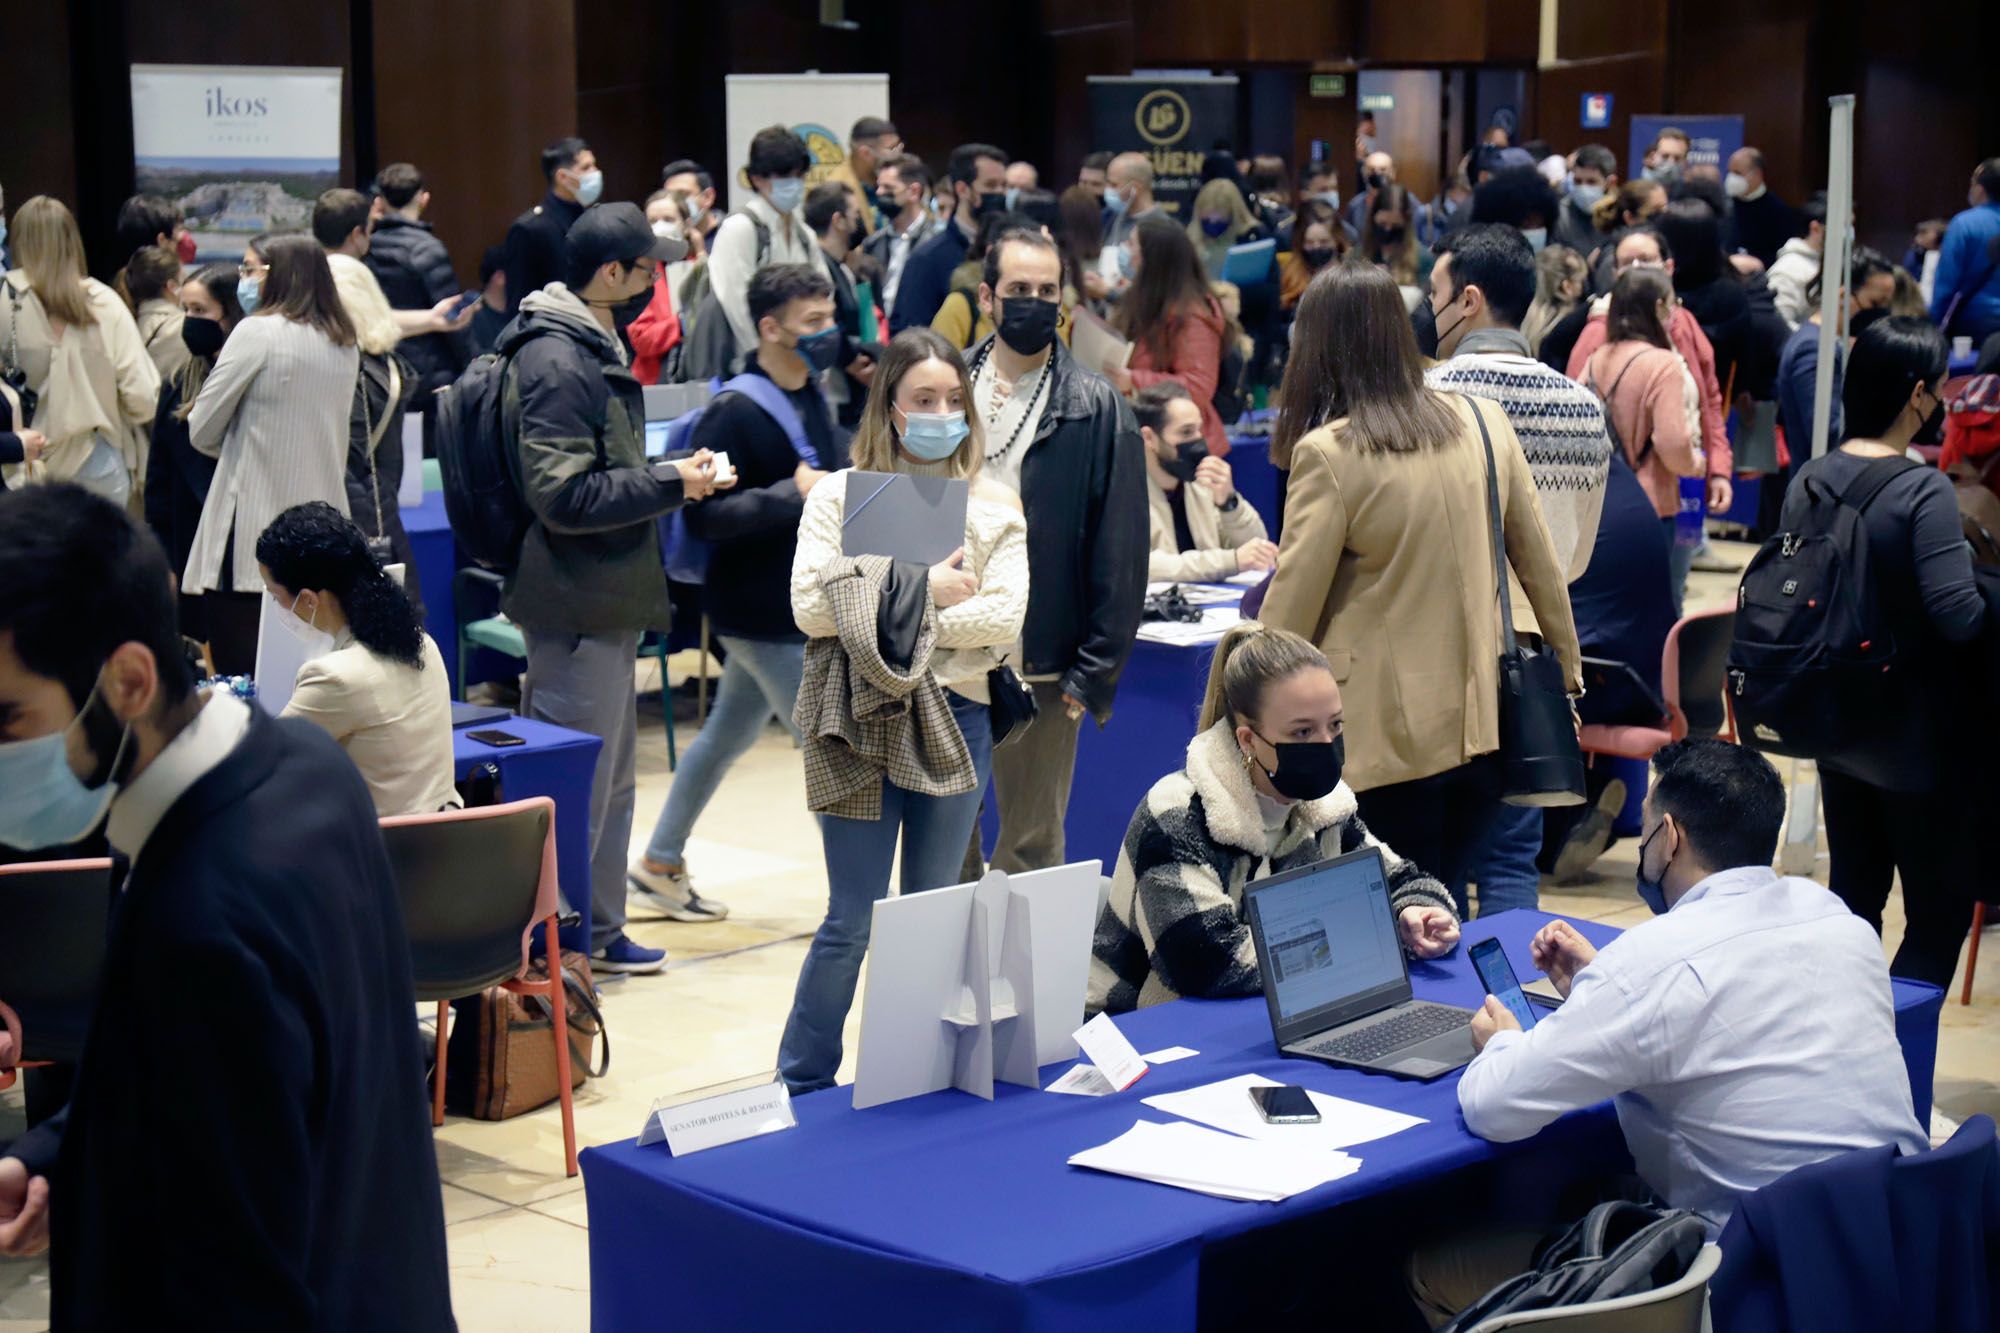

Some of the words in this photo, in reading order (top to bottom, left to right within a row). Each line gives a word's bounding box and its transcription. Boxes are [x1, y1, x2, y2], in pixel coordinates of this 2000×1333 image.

[206, 86, 267, 117] ikos
[670, 1117, 708, 1132] SENATOR
[708, 1109, 741, 1124] HOTELS
[741, 1106, 748, 1115] &
